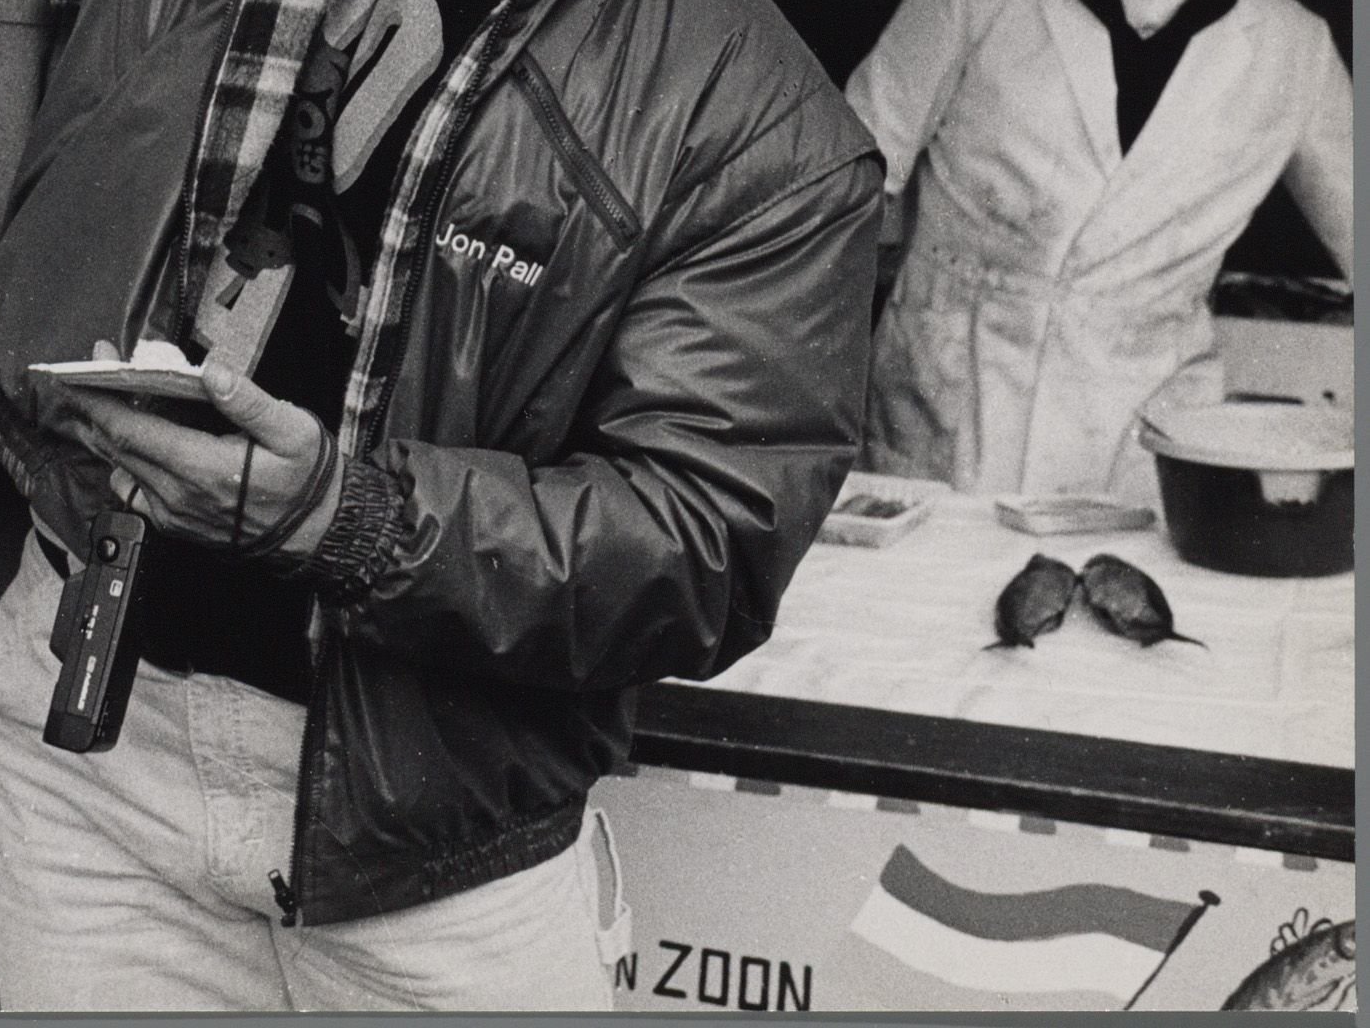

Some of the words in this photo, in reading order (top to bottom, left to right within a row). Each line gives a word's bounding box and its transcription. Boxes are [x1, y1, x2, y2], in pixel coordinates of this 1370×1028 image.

[435, 223, 486, 260] Jon
[491, 244, 544, 287] Pall
[652, 939, 813, 1011] ZOON
